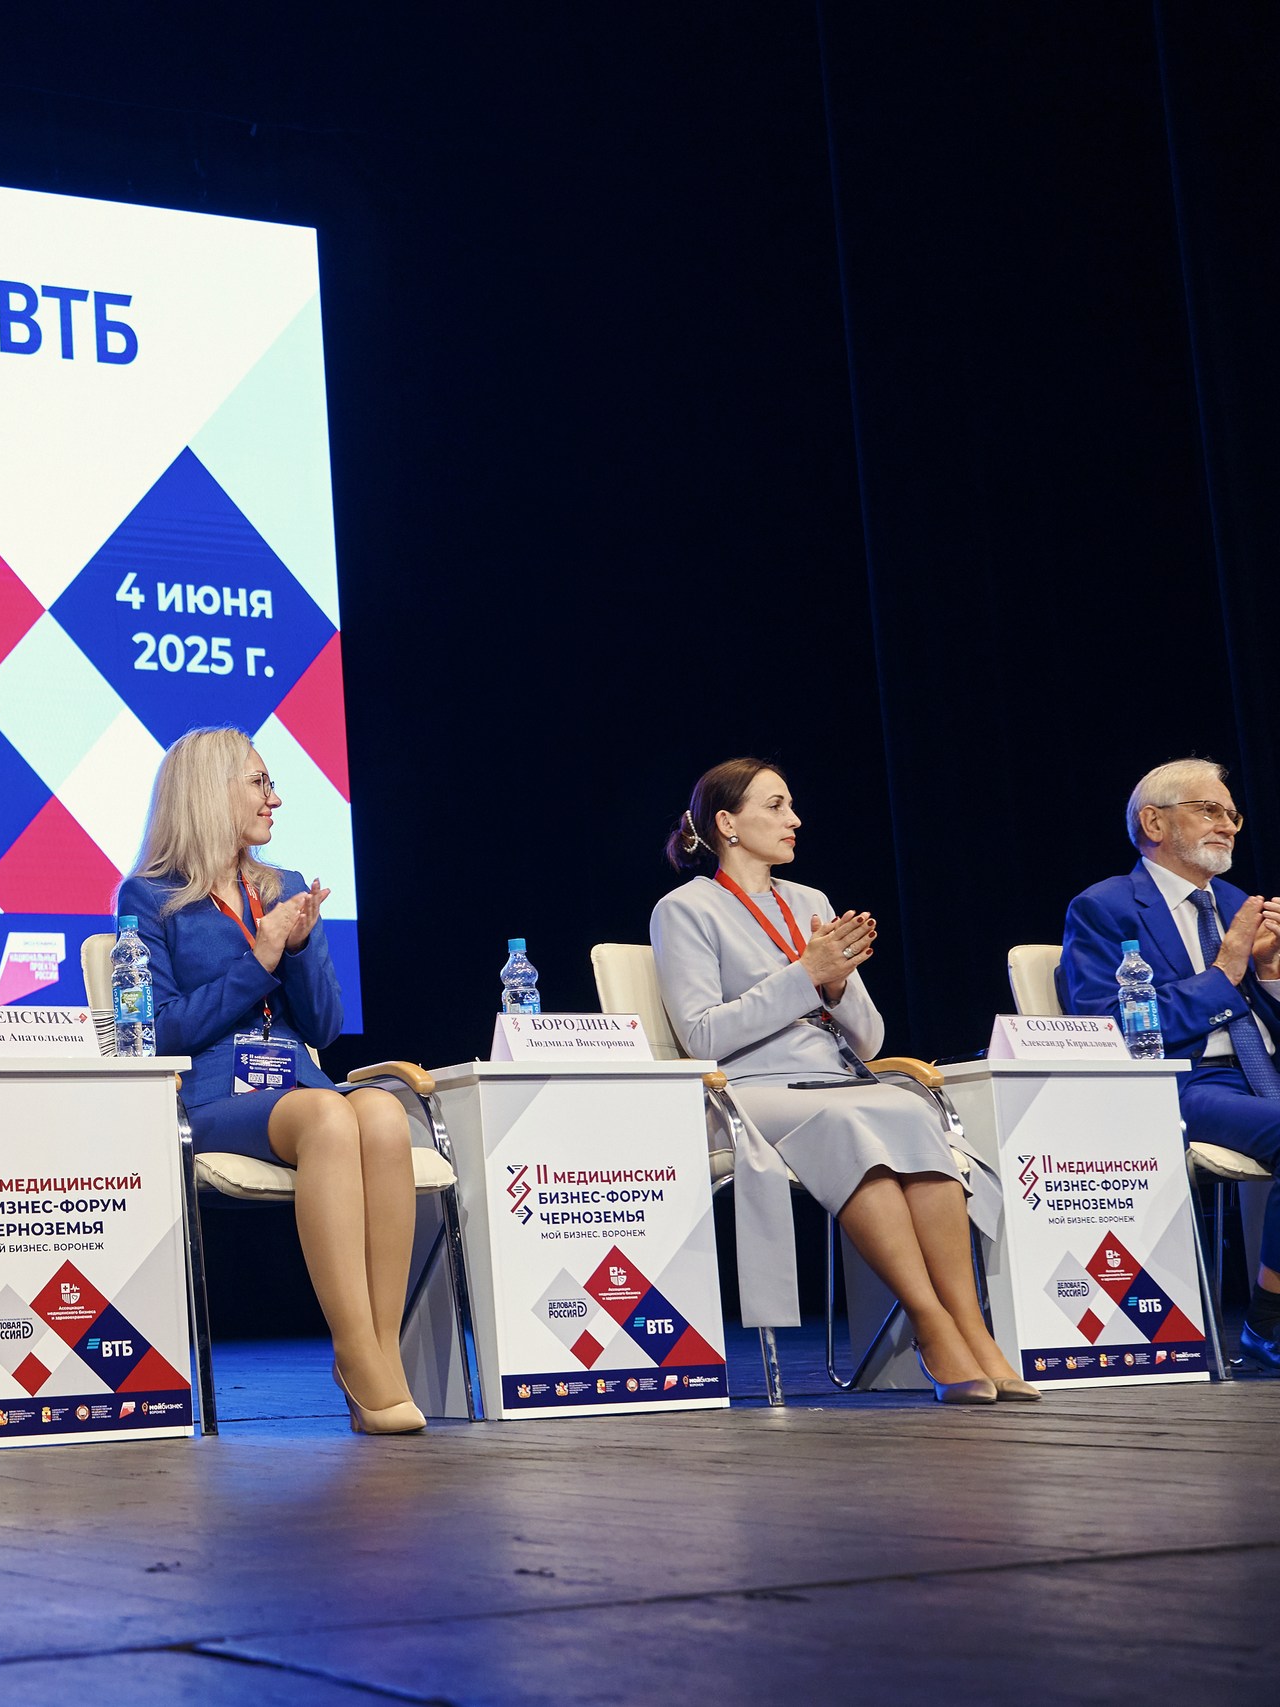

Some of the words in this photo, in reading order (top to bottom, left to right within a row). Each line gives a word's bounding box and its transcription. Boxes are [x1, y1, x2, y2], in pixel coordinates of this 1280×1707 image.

[115, 572, 145, 610] 4
[157, 582, 273, 619] июня
[131, 632, 234, 676] 2025
[245, 647, 275, 678] г.
[531, 1018, 620, 1031] БОРОДИНА
[1026, 1019, 1099, 1032] СОЛОВЬЕВ
[9, 1033, 84, 1043] Анатольевна
[526, 1038, 573, 1048] Людмила
[575, 1038, 635, 1048] Викторовна
[1021, 1039, 1065, 1049] Александр
[1066, 1039, 1117, 1049] Кириллович
[1042, 1155, 1052, 1173] II
[1057, 1157, 1158, 1175] МЕДИЦИНСКИЙ
[536, 1164, 548, 1184] II
[553, 1166, 676, 1185] МЕДИЦИНСКИЙ
[0, 1173, 141, 1194] МЕДИЦИНСКИЙ
[1045, 1179, 1149, 1192] БИЗНЕС-ФОРУМ
[538, 1189, 664, 1204] БИЗНЕС-ФОРУМ
[1047, 1198, 1133, 1211] ЧЕРНОЗЕМЬЯ
[540, 1210, 645, 1224] ЧЕРНОЗЕМЬЯ
[1048, 1216, 1065, 1224] МОЙ
[1067, 1216, 1097, 1224] БИЗНЕС.
[1099, 1215, 1135, 1223] ВОРОНЕЖ
[541, 1230, 561, 1239] МОЙ
[563, 1230, 600, 1239] БИЗНЕС.
[602, 1229, 646, 1238] ВОРОНЕЖ
[9, 1243, 50, 1252] БИЗНЕС.
[53, 1242, 104, 1251] ВОРОНЕЖ
[1057, 1289, 1081, 1297] РОССИЯ
[548, 1301, 576, 1309] ДЕЛОВАЯ
[1138, 1298, 1162, 1313] ВТБ
[548, 1309, 576, 1318] РОССИЯ
[646, 1319, 674, 1334] ВТБ
[102, 1340, 133, 1357] ВТБ
